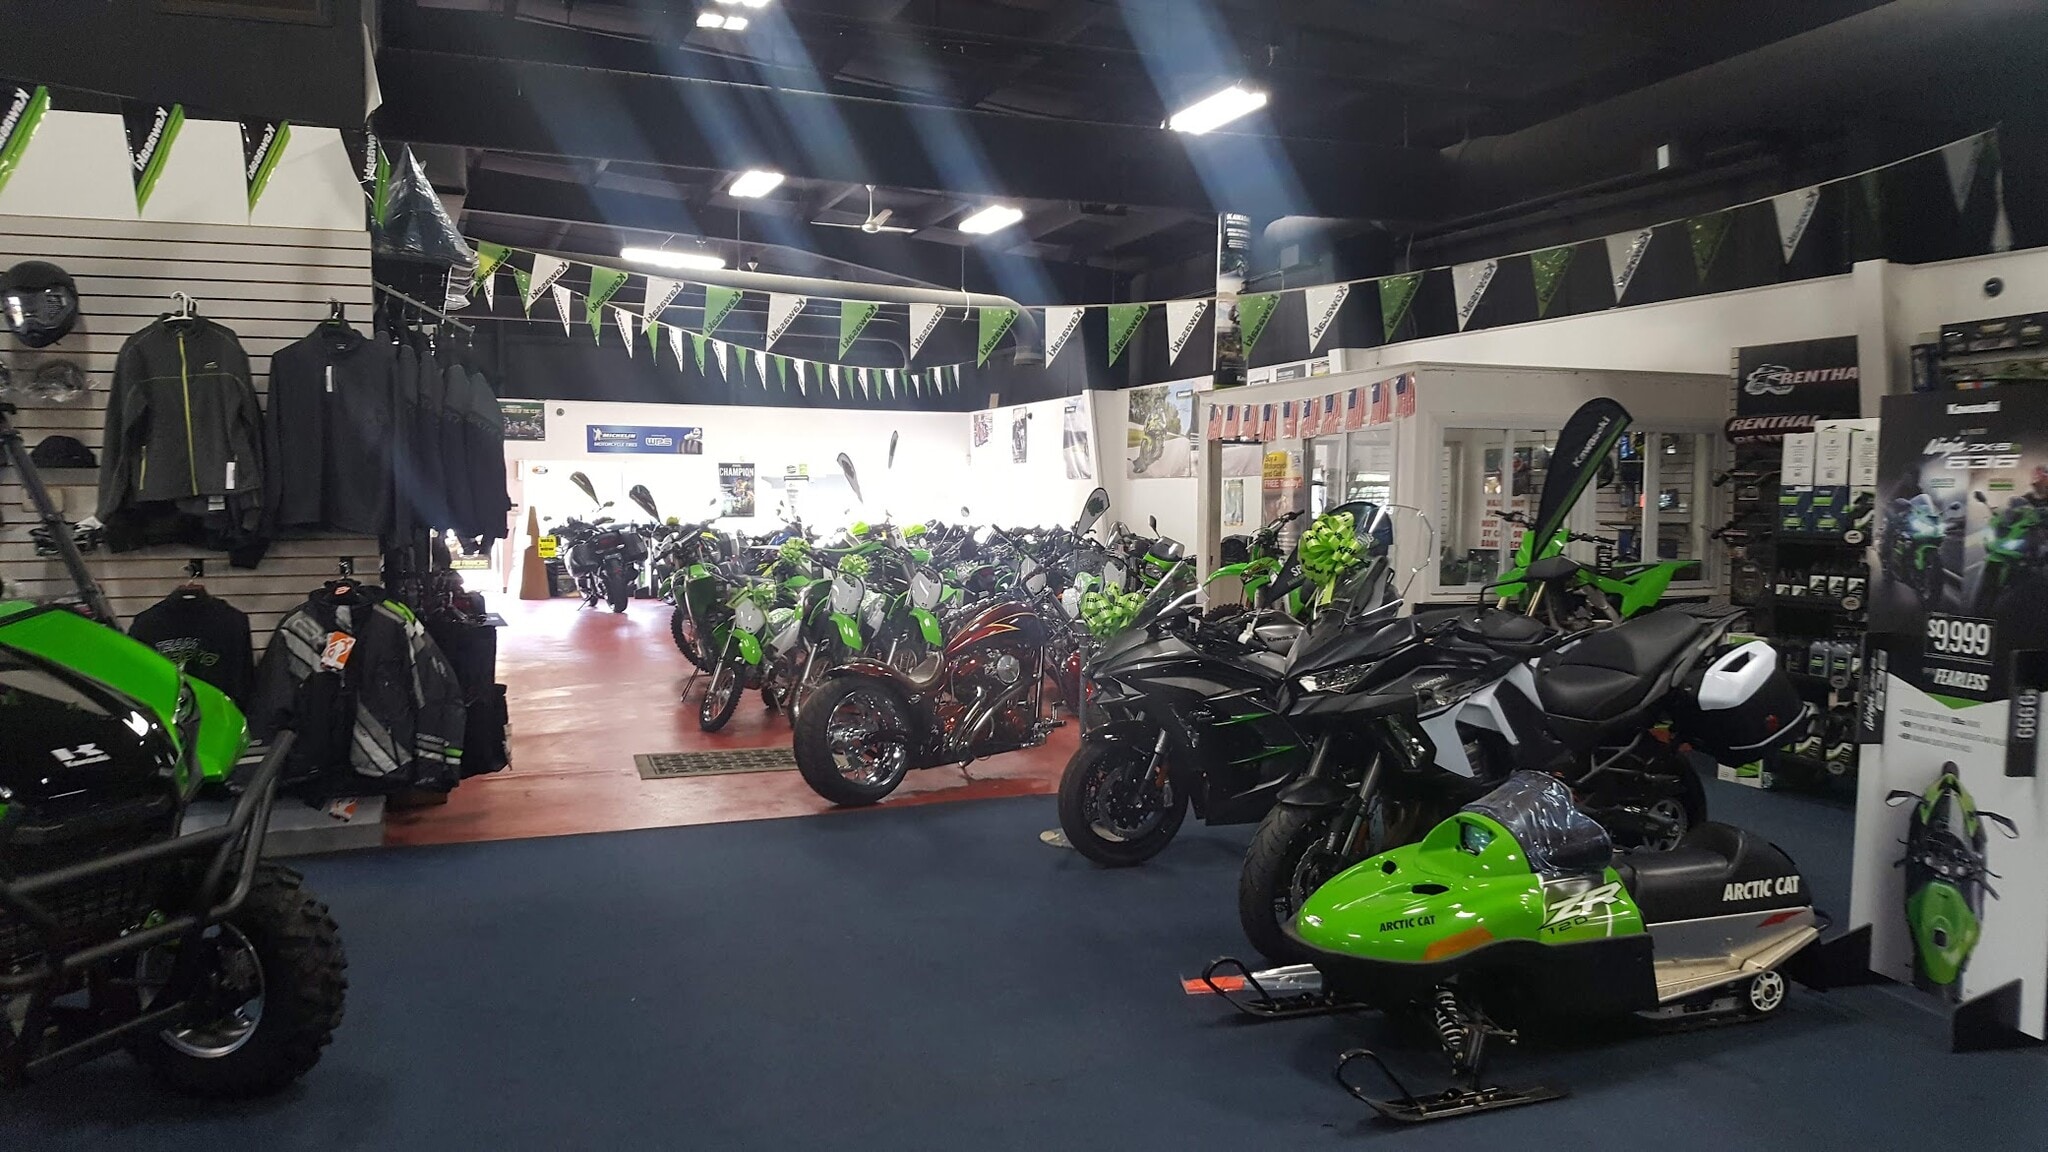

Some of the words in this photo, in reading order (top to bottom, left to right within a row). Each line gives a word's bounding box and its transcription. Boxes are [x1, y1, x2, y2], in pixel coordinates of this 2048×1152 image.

[1780, 367, 1858, 384] RENTHA
[1572, 416, 1610, 467] Kawasaki
[1945, 453, 2022, 469] 636
[720, 467, 754, 477] CHAMPION
[1722, 879, 1773, 901] ARCTIC
[1775, 875, 1800, 895] CAT
[1542, 881, 1623, 928] ZR
[1380, 918, 1415, 932] ARCTIC
[1418, 915, 1435, 926] CAT
[1548, 915, 1588, 934] 120
